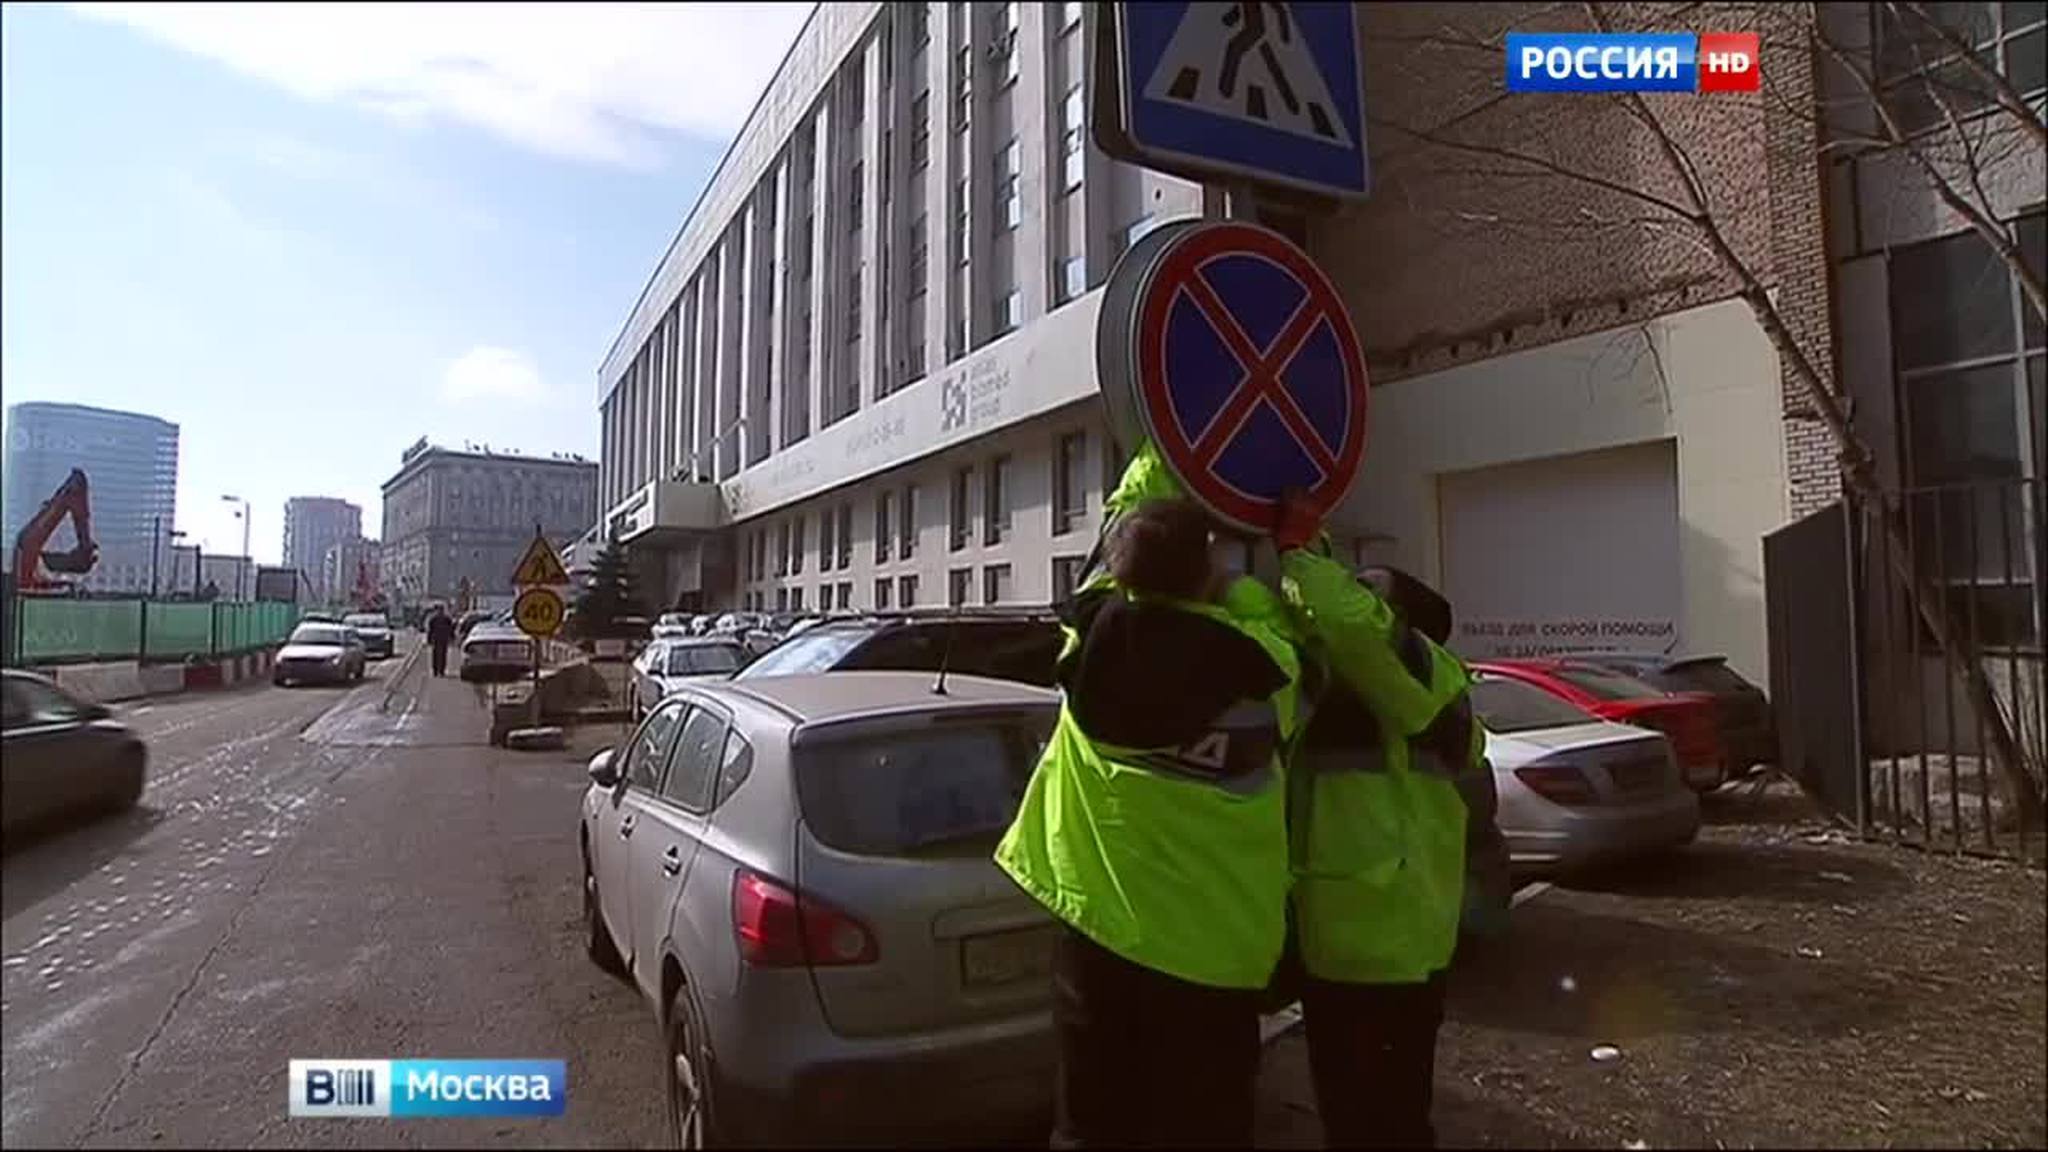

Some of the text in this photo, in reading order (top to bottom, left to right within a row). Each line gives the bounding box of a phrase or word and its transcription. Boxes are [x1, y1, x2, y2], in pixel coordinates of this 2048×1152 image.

[524, 602, 552, 620] 40
[1507, 622, 1536, 637] ДЛЯ
[1541, 619, 1598, 637] СКОРОЙ
[1601, 621, 1674, 638] ПОМОЩИ
